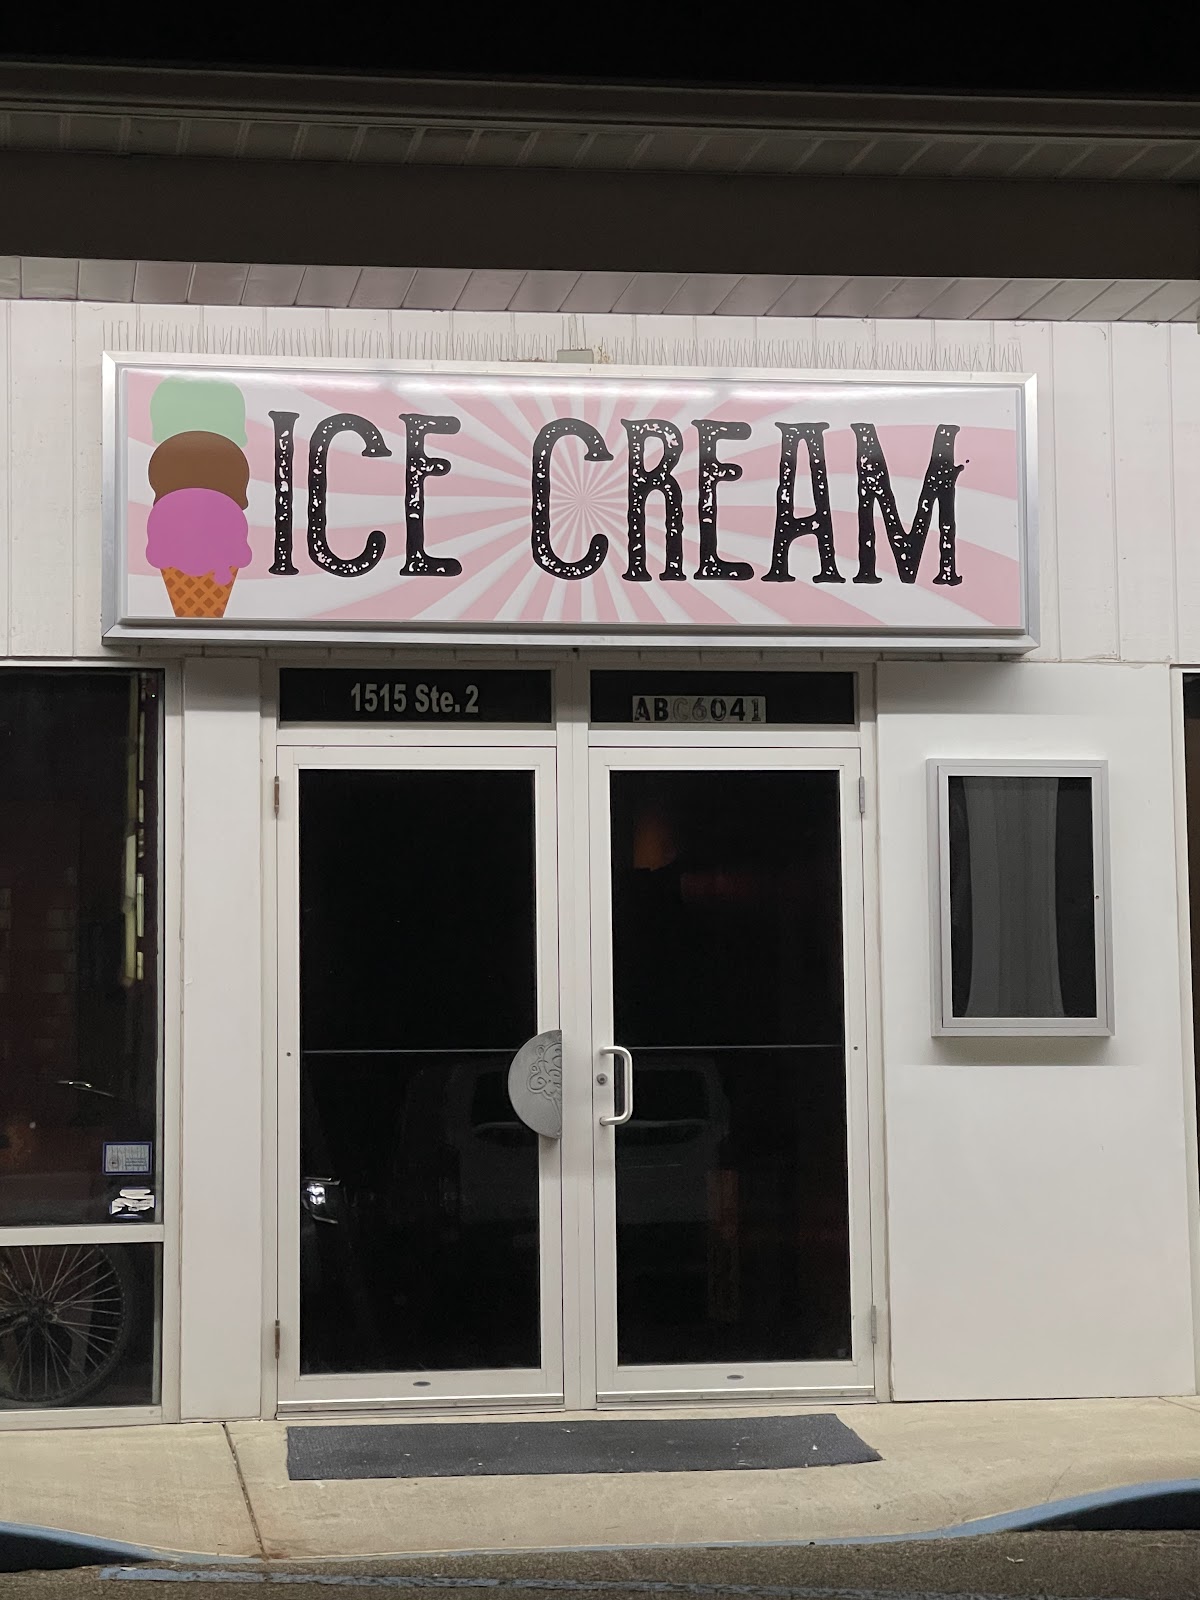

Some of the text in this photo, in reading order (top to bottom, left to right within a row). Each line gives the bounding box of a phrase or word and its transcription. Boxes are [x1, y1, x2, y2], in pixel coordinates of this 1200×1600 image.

[268, 411, 965, 586] ICE CREAM
[351, 683, 479, 713] 1515 Ste. 2
